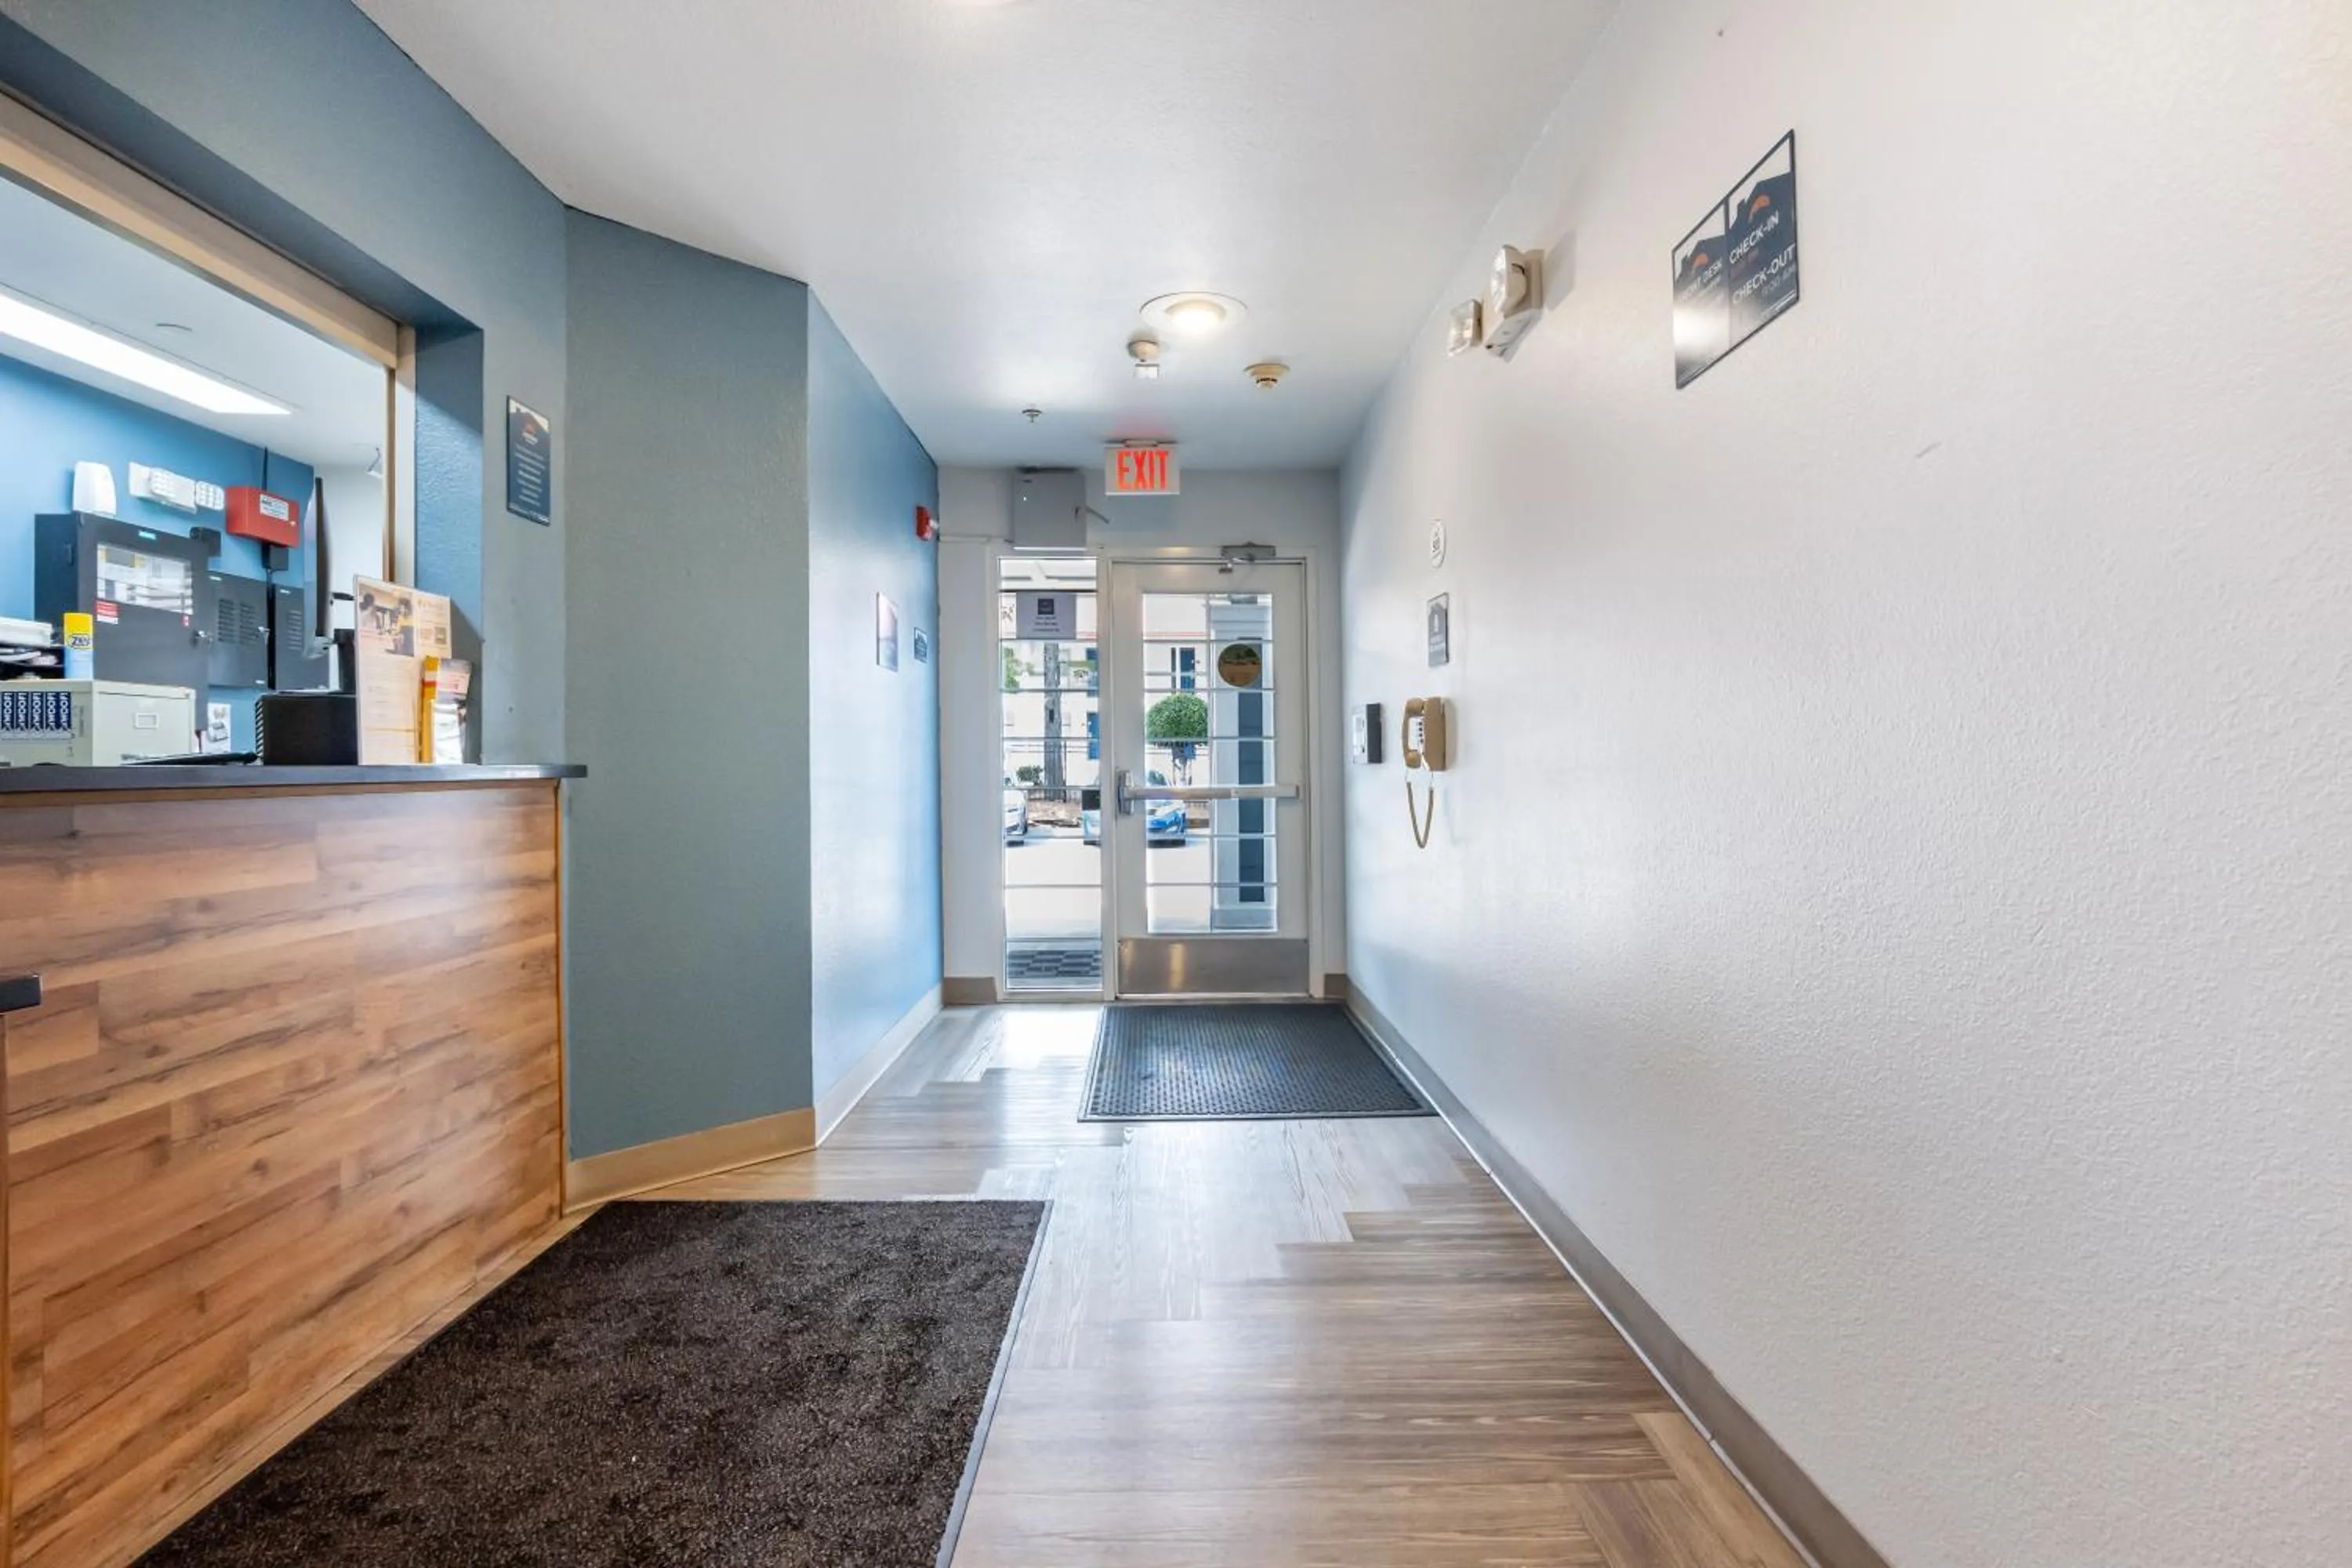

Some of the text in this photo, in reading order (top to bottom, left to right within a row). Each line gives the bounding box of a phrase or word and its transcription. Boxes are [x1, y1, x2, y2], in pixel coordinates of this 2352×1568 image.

[1729, 209, 1779, 264] CHECK-IN
[1732, 242, 1796, 304] CHECK-OUT
[1116, 449, 1168, 492] EXIT
